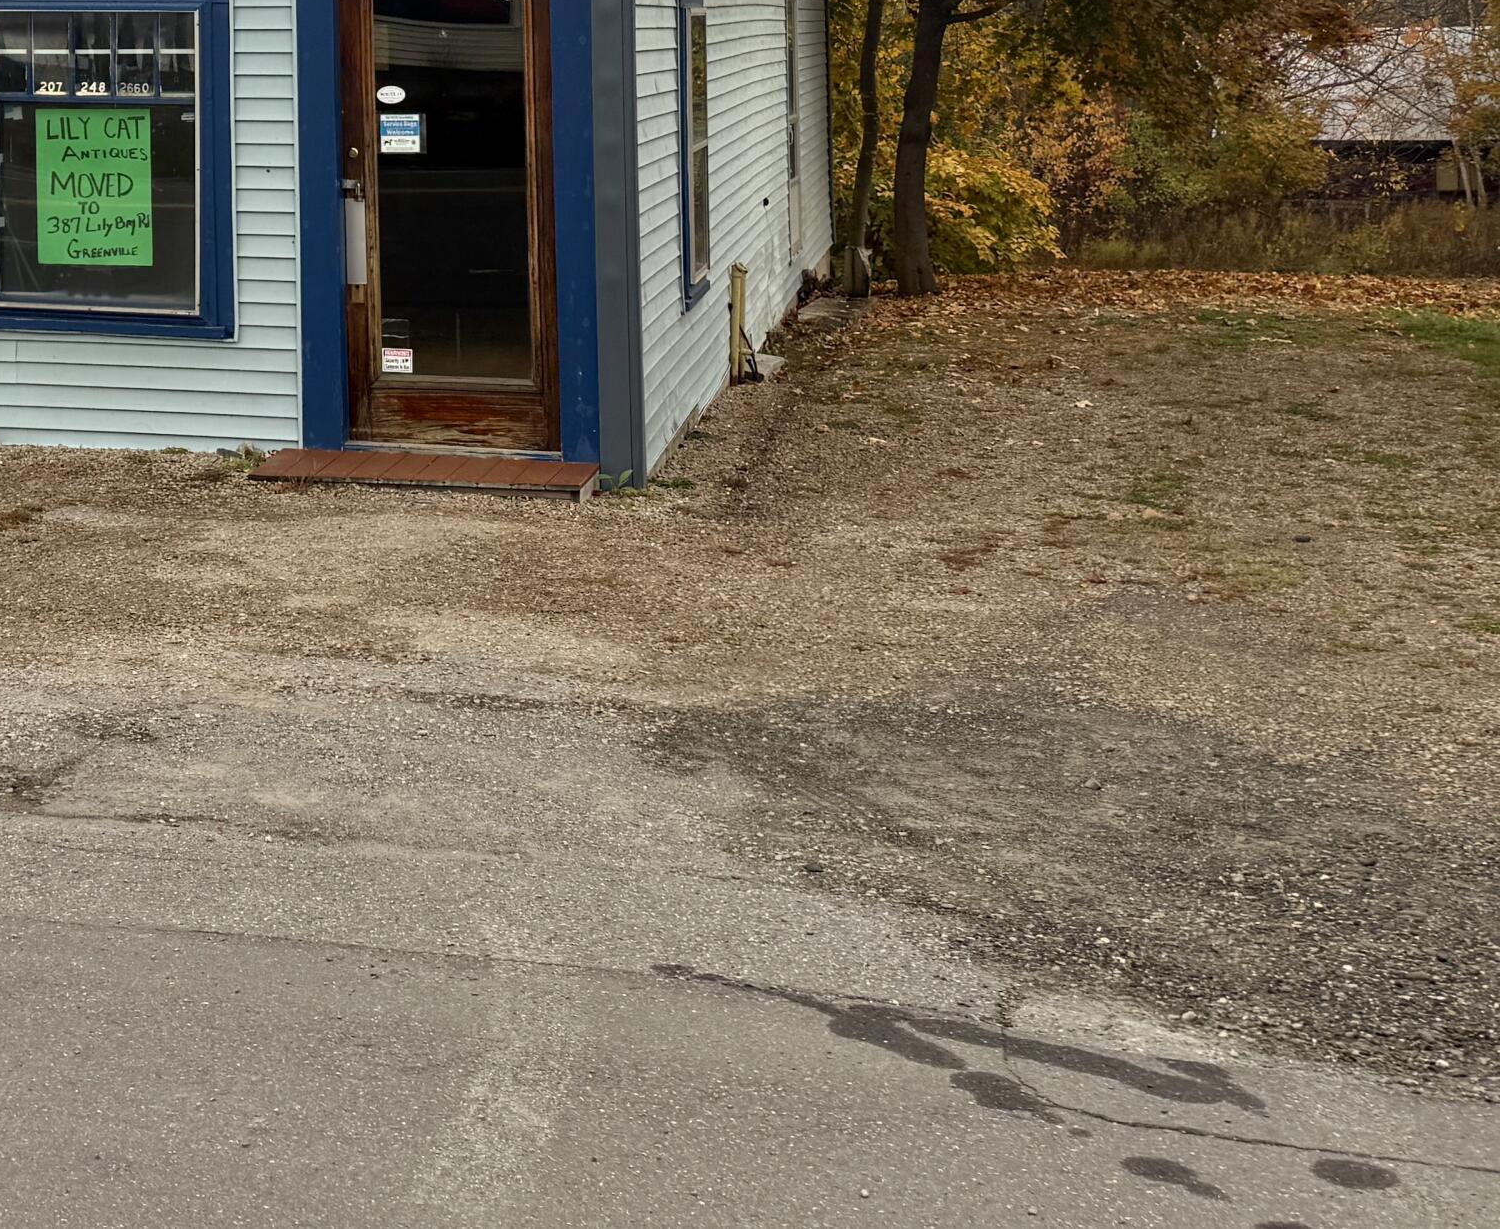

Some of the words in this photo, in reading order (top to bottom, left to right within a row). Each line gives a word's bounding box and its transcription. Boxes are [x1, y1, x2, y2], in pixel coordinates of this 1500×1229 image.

[40, 81, 63, 92] 207
[81, 81, 106, 92] 248
[120, 82, 149, 93] 2660
[46, 116, 91, 140] LILY
[104, 116, 146, 139] CAT
[61, 146, 148, 162] ANTIQUES
[51, 171, 134, 198] MOVED
[78, 201, 100, 215] TO
[47, 216, 81, 234] 387
[85, 217, 113, 237] Lily
[67, 238, 138, 259] GREENVILLE
